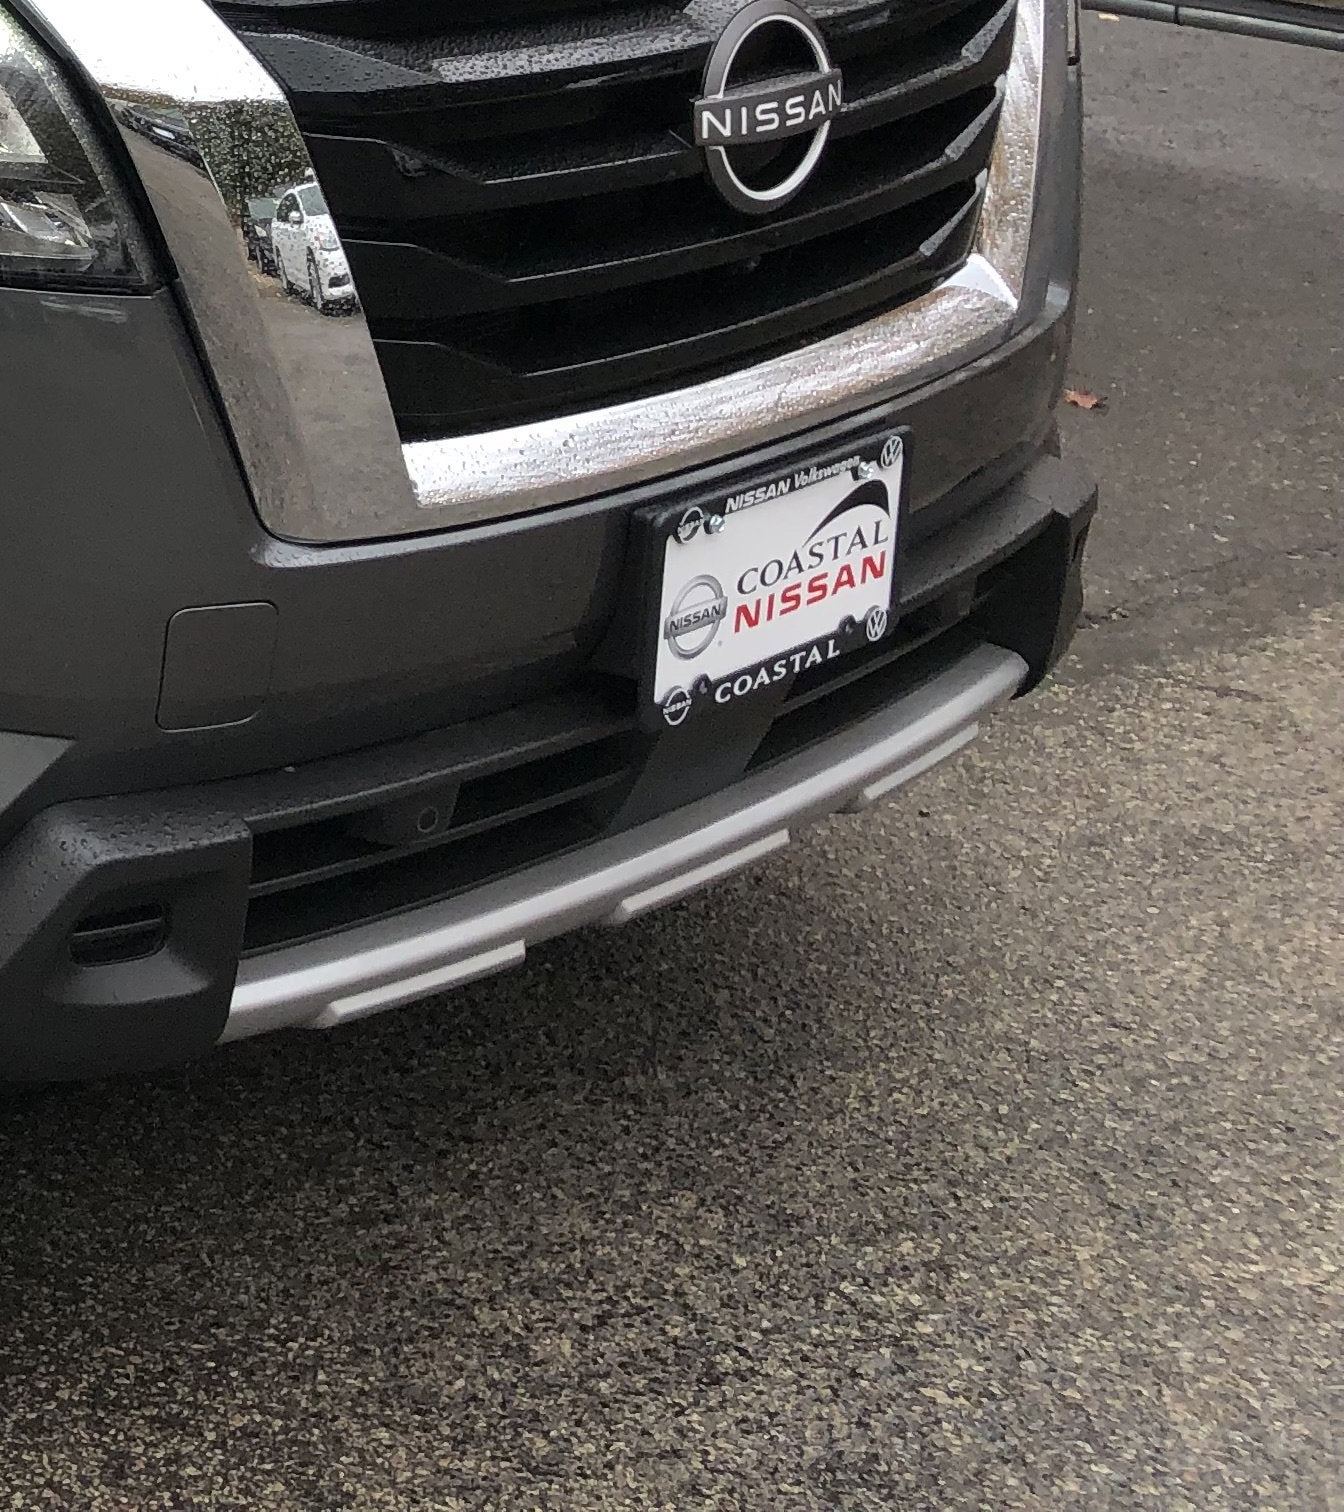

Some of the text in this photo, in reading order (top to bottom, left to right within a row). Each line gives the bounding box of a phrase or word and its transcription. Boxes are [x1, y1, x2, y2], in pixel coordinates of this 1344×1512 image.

[701, 79, 843, 139] NISSAN
[724, 455, 861, 514] NISSAN Volkswagen
[736, 519, 890, 596] COASTAL
[668, 603, 723, 632] NISSAN
[733, 550, 888, 634] NISSAN
[714, 638, 842, 704] COASTAL
